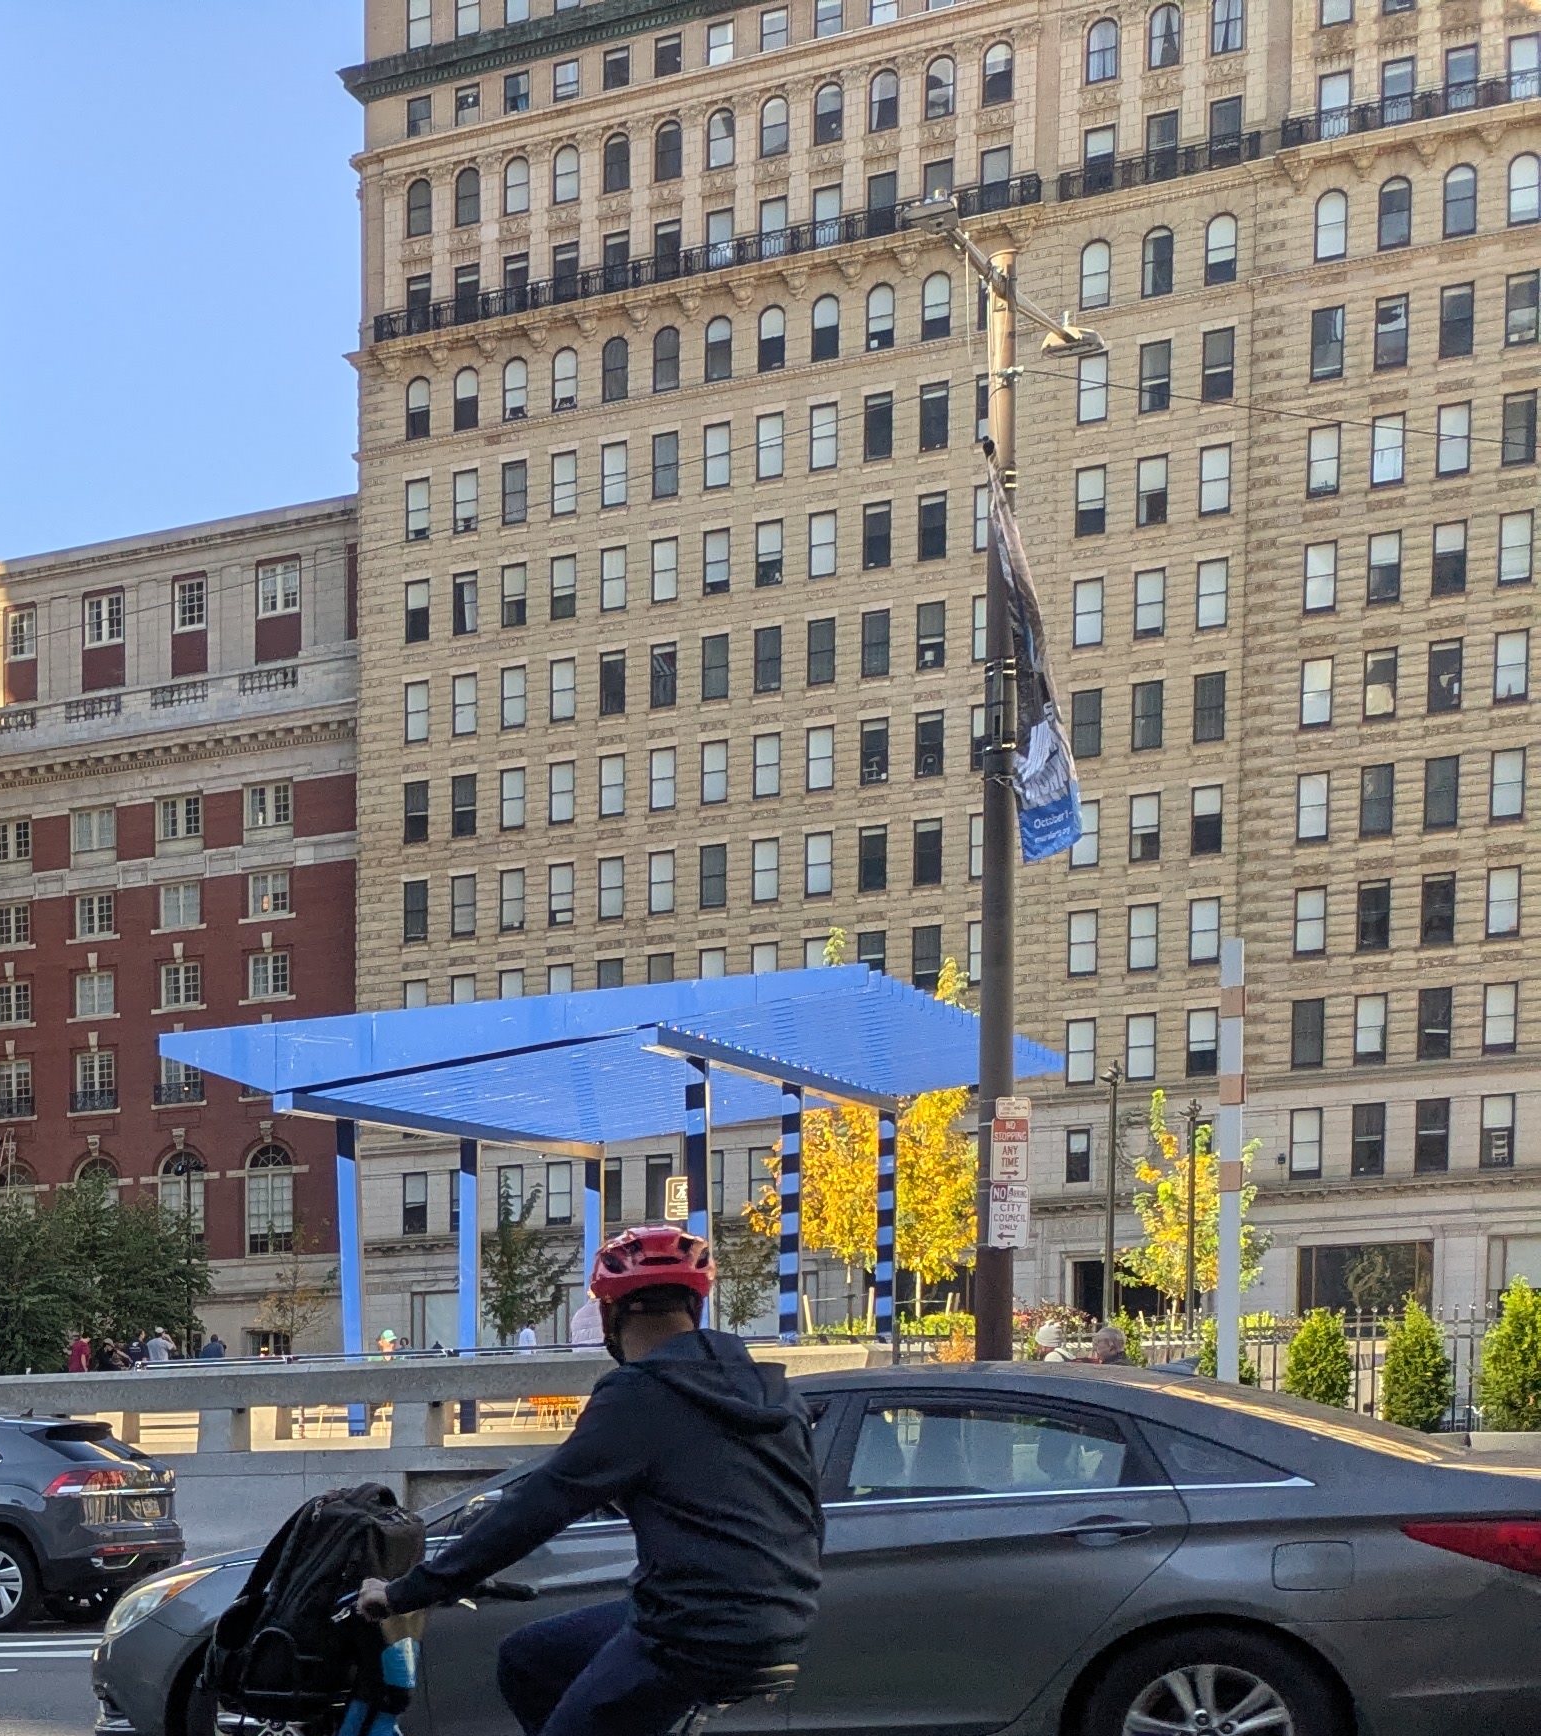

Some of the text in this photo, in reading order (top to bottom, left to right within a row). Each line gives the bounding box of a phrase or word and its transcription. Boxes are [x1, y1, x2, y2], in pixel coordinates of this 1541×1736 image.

[1005, 1121, 1016, 1130] NO
[994, 1132, 1027, 1140] STOPPING
[1002, 1146, 1018, 1156] ANY
[1002, 1157, 1019, 1167] TIME
[993, 1187, 1007, 1200] NO
[1000, 1204, 1022, 1212] CITY
[993, 1214, 1026, 1222] COUNCIL
